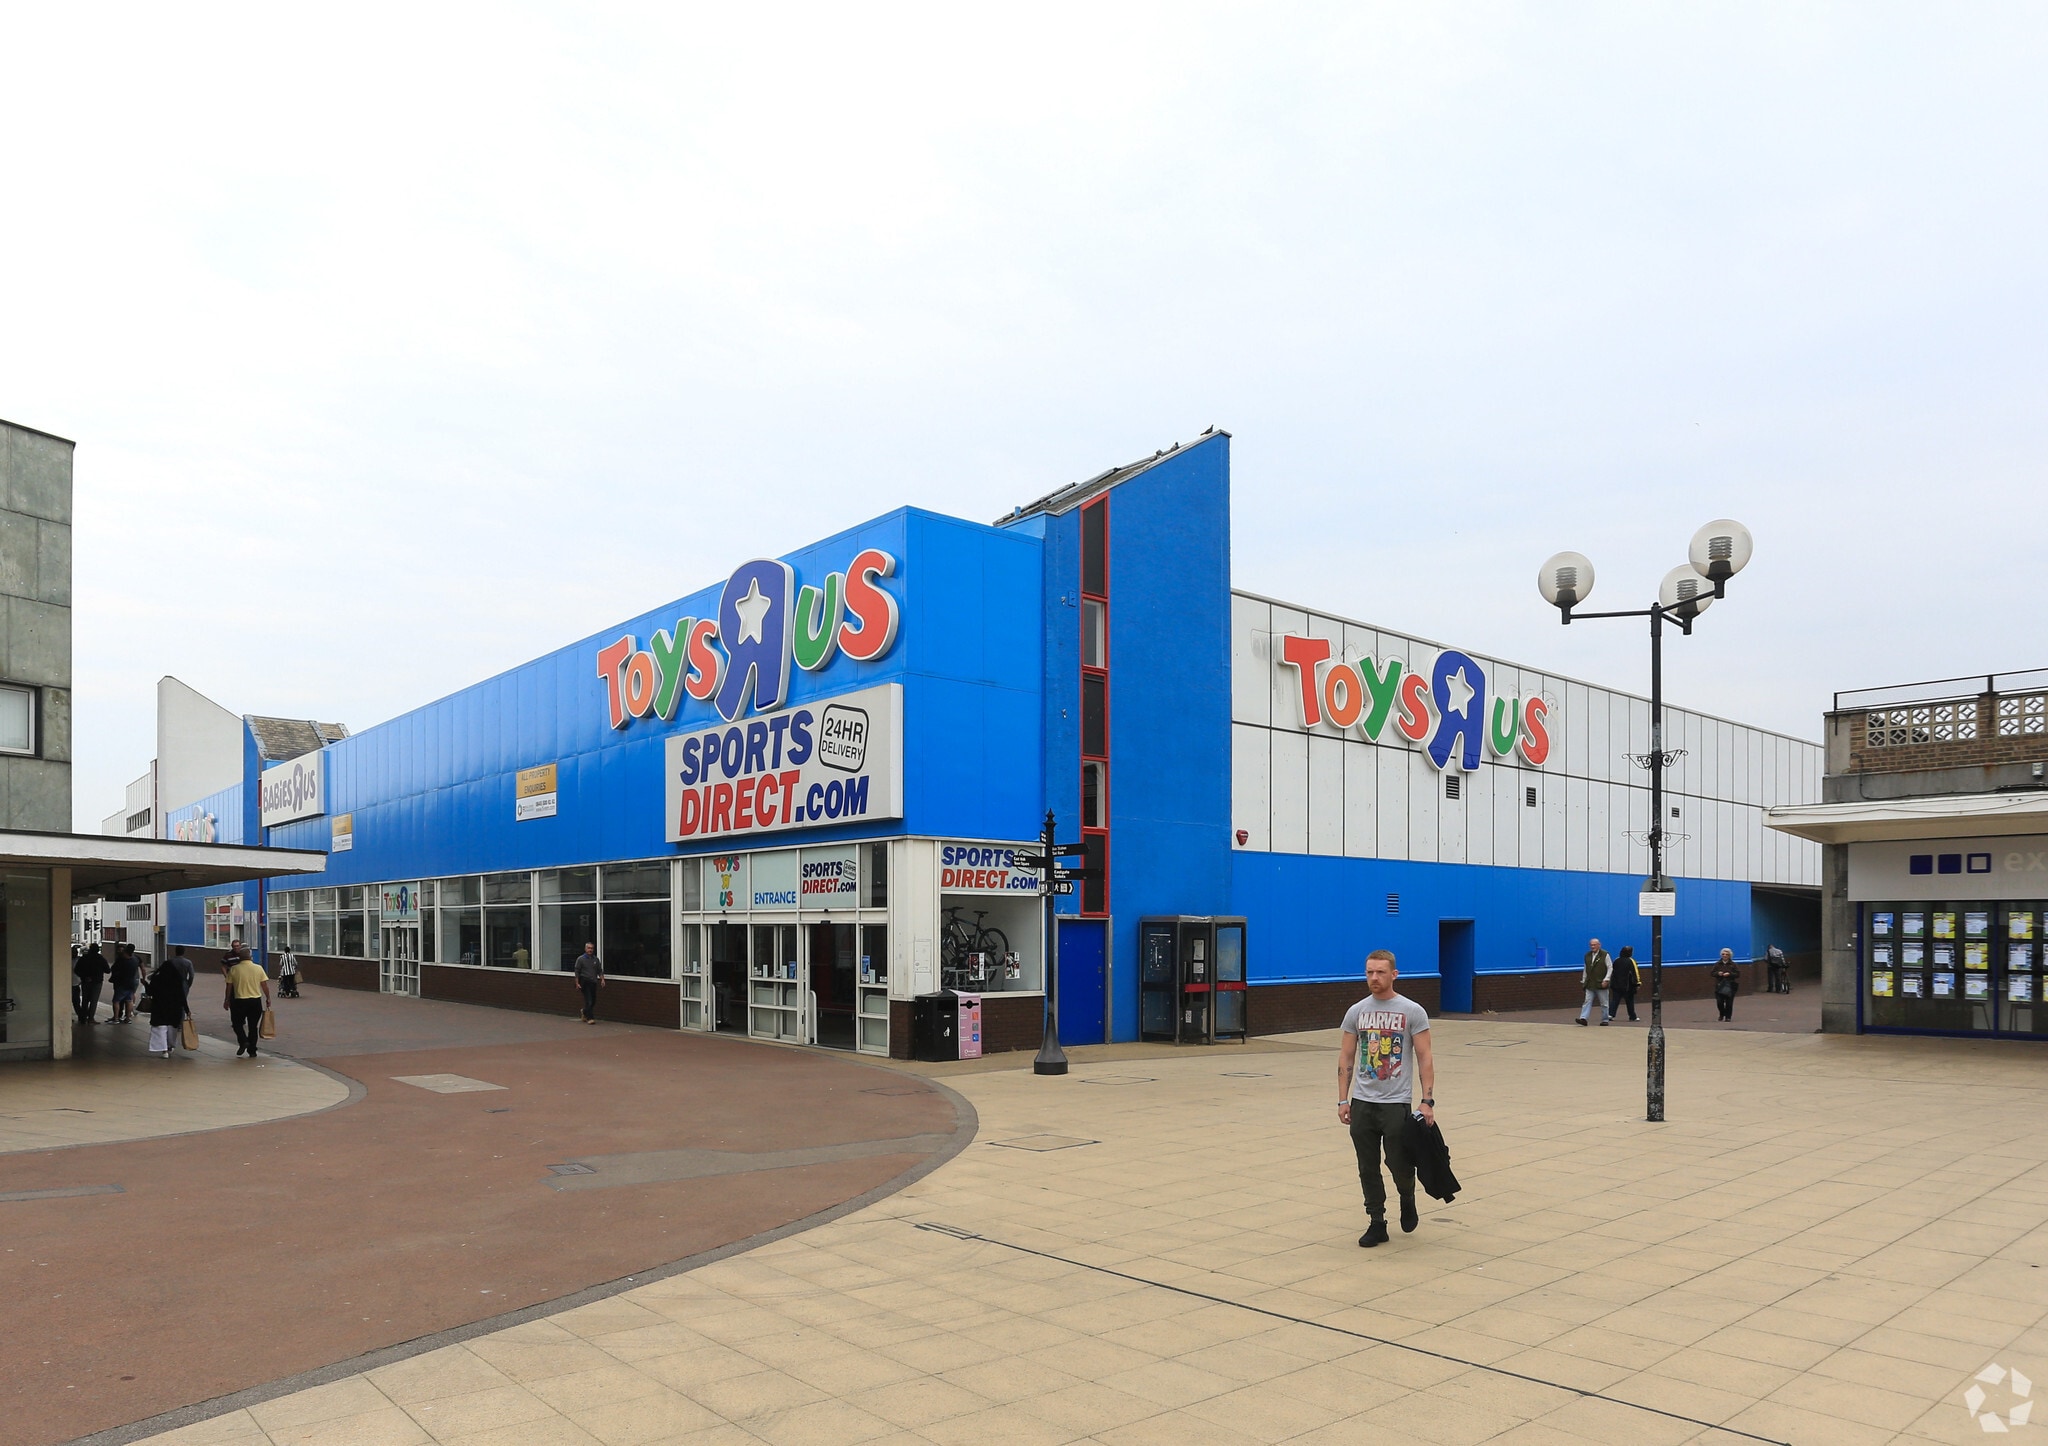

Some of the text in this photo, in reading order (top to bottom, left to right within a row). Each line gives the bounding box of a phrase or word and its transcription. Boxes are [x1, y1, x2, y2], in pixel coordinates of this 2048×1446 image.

[825, 717, 864, 744] 24HR
[679, 709, 815, 786] SPORTS
[821, 740, 863, 761] DELIVERY
[679, 770, 870, 837] DIRECT.COM
[713, 855, 740, 873] TOYS
[941, 846, 1016, 868] SPORTS
[802, 861, 843, 878] SPORTS
[941, 868, 1038, 889] DIRECT.COM
[802, 878, 857, 894] DIRECT.COM
[719, 890, 734, 907] US
[754, 890, 797, 905] ENTRANCE
[1358, 1010, 1406, 1032] MARVEL
